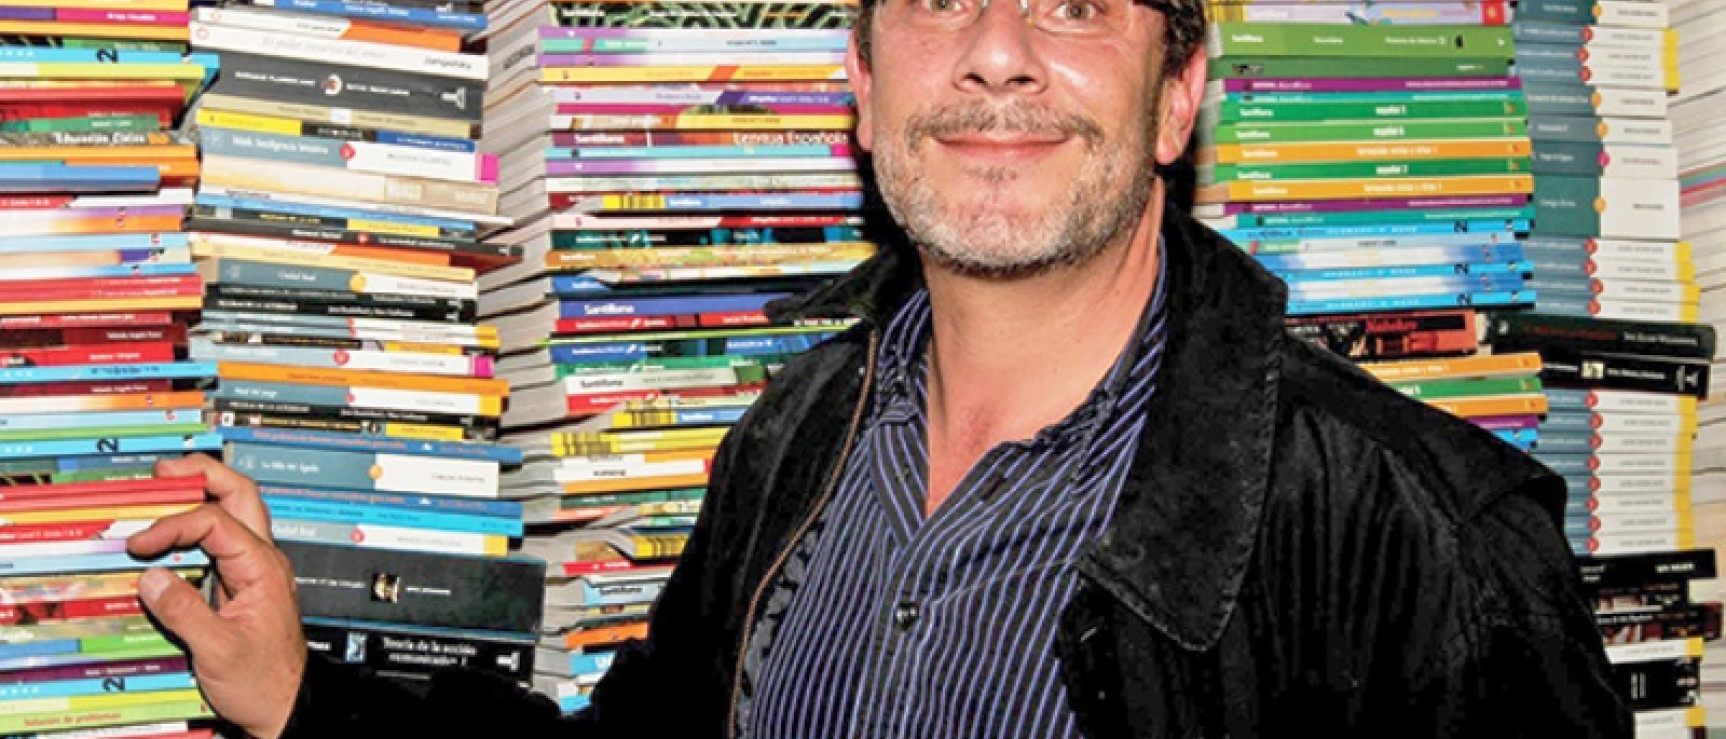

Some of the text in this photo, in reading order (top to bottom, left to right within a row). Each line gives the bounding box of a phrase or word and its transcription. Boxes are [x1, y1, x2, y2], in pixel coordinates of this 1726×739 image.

[96, 48, 118, 63] 2
[574, 134, 625, 144] Santillana
[583, 303, 635, 315] Santillana
[580, 379, 623, 388] Santillana
[96, 438, 119, 453] 2
[382, 636, 413, 650] Teoría
[103, 676, 125, 692] 2
